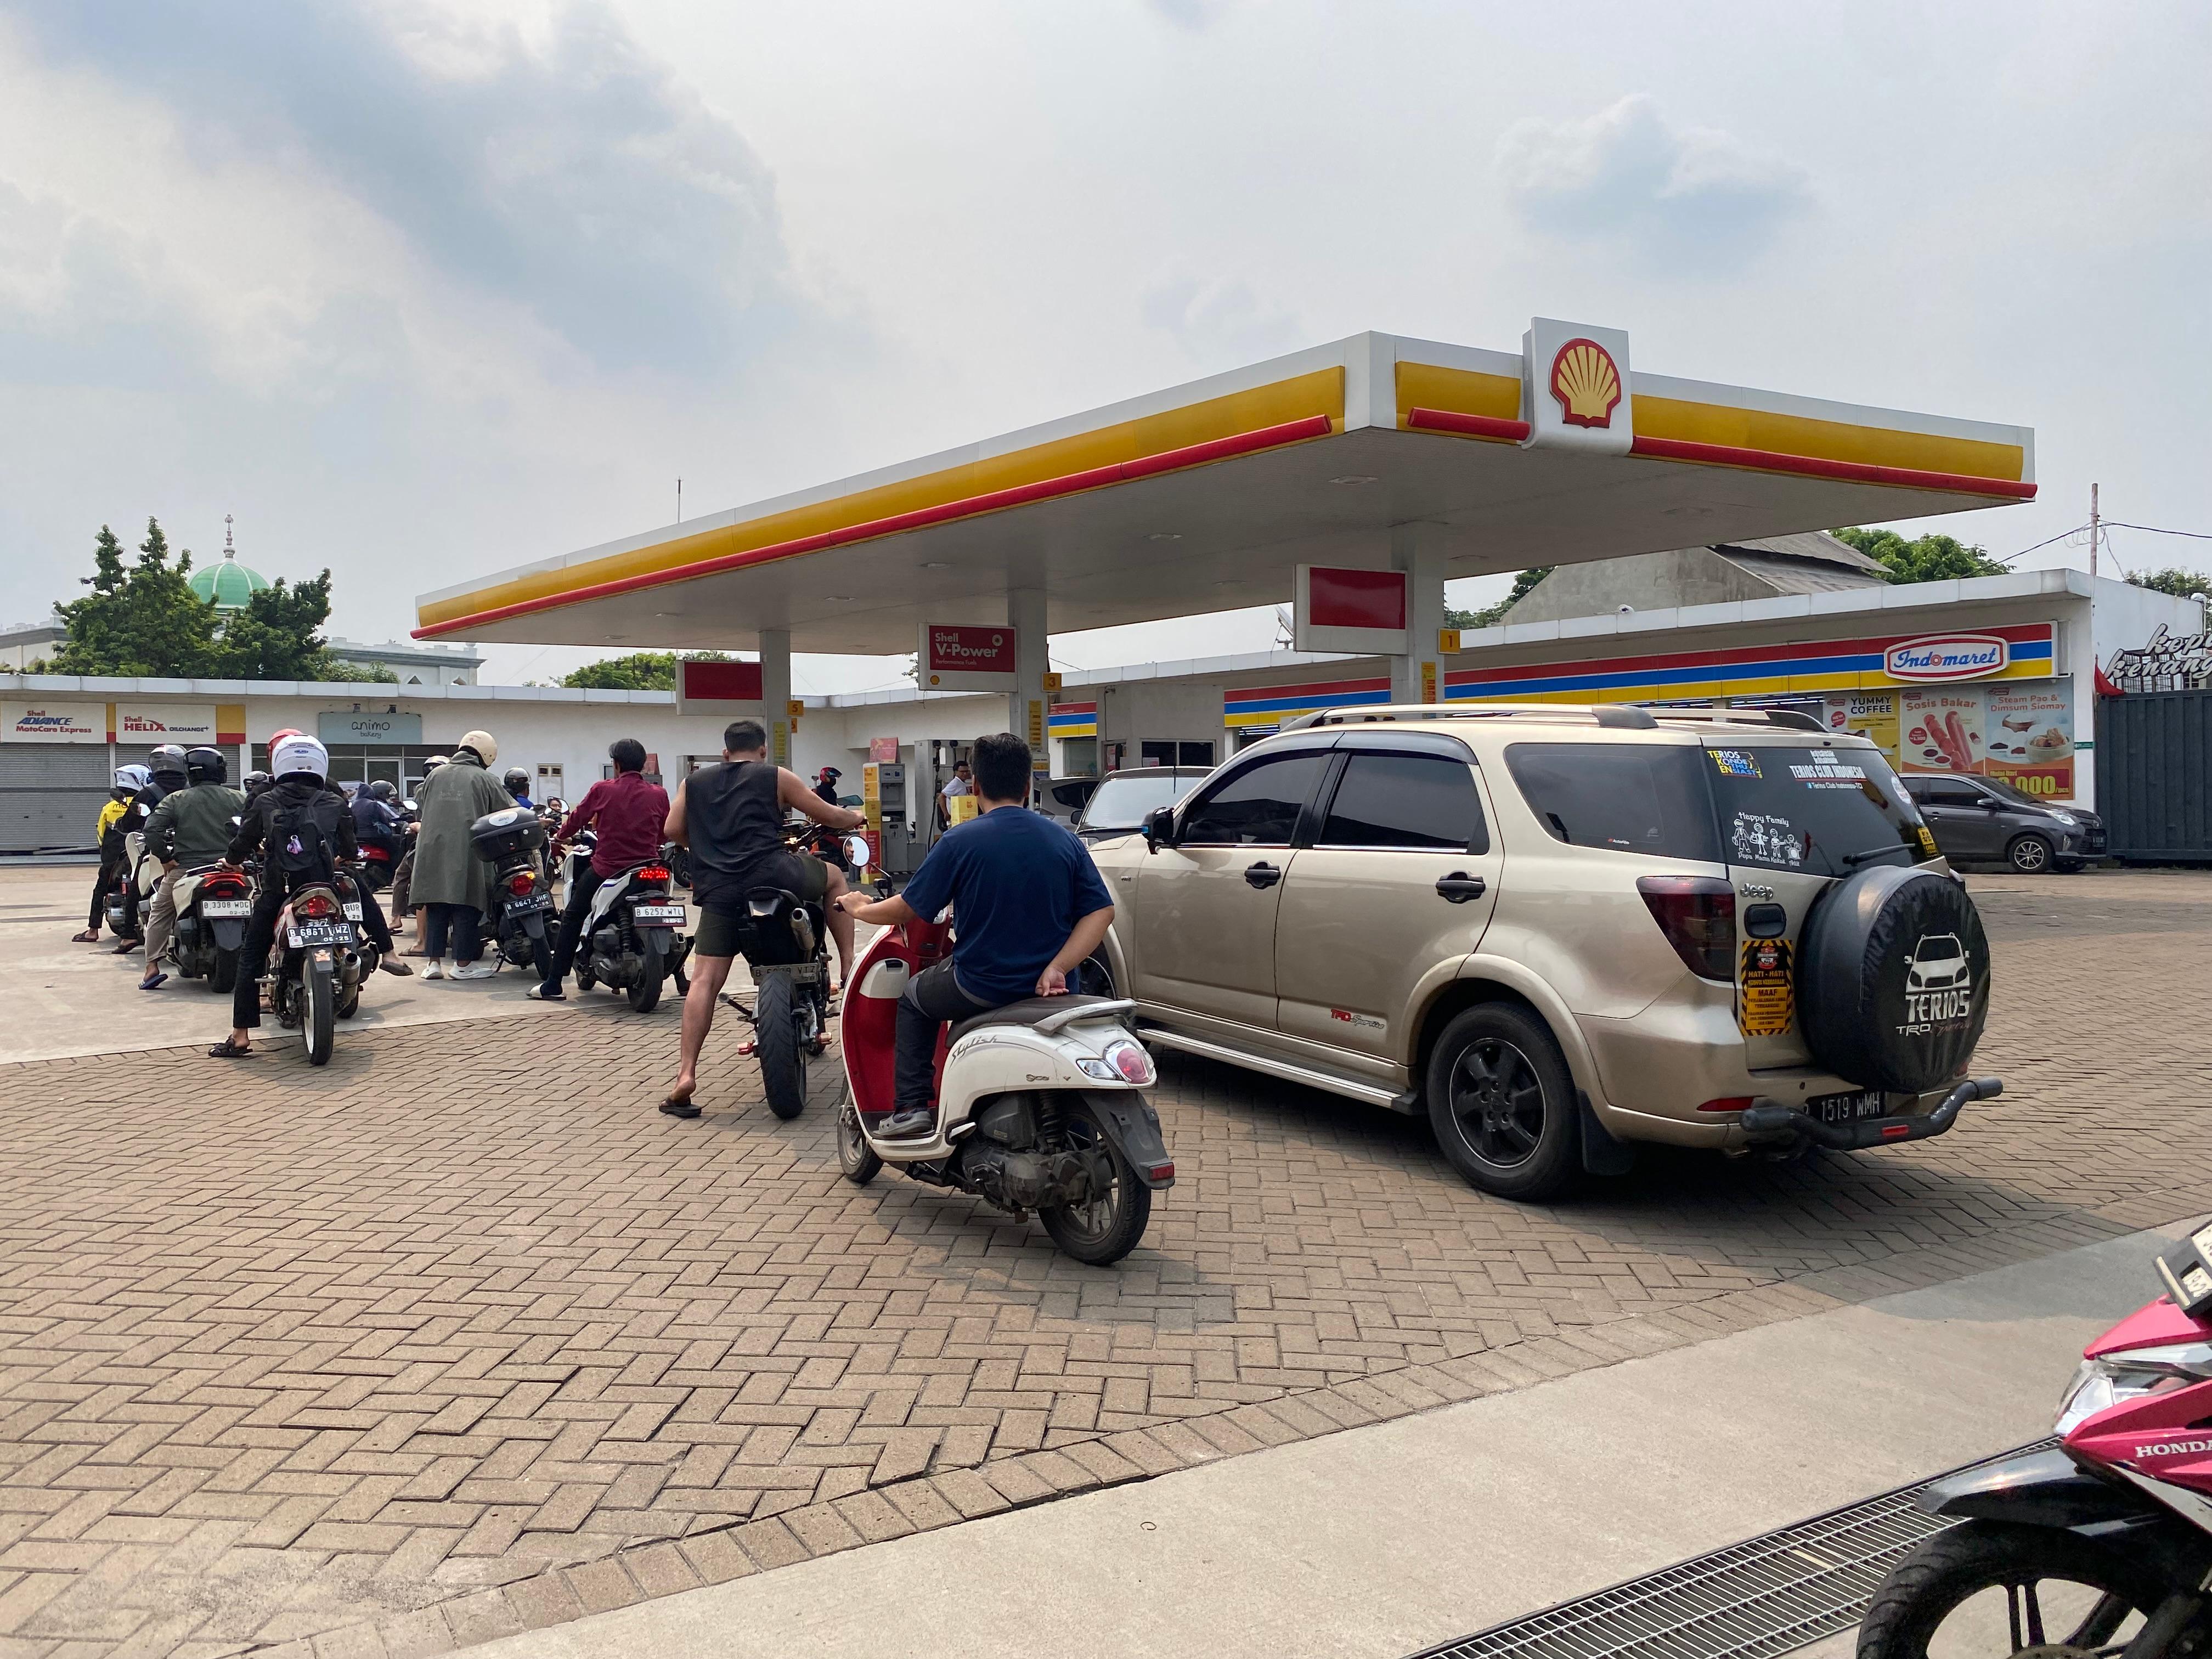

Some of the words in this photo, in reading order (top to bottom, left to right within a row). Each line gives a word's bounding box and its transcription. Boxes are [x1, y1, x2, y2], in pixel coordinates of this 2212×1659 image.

[935, 633, 958, 642] Shell
[1448, 635, 1453, 647] 1
[935, 643, 998, 657] V-Power
[1894, 647, 1996, 668] Indomaret
[1049, 677, 1056, 687] 3
[1851, 696, 1891, 705] YUMMY
[1906, 699, 1937, 711] Sosis
[1941, 698, 1976, 708] Bakar
[792, 704, 798, 713] 5
[1850, 705, 1892, 714] COFFEE
[17, 717, 74, 725] ADVANCE
[124, 720, 167, 731] HELIX
[352, 719, 390, 730] animo
[60, 726, 92, 735] Express
[1707, 751, 1740, 759] TERIOS
[1789, 765, 1817, 778] TERIOS
[1739, 812, 1764, 823] Happy
[1765, 816, 1789, 827] Family
[1740, 883, 1773, 901] Jeep
[1905, 990, 1970, 1023] TERIOS
[1331, 1009, 1351, 1022] TRD
[1896, 1024, 1931, 1036] TRD
[1821, 1097, 1849, 1122] 1519
